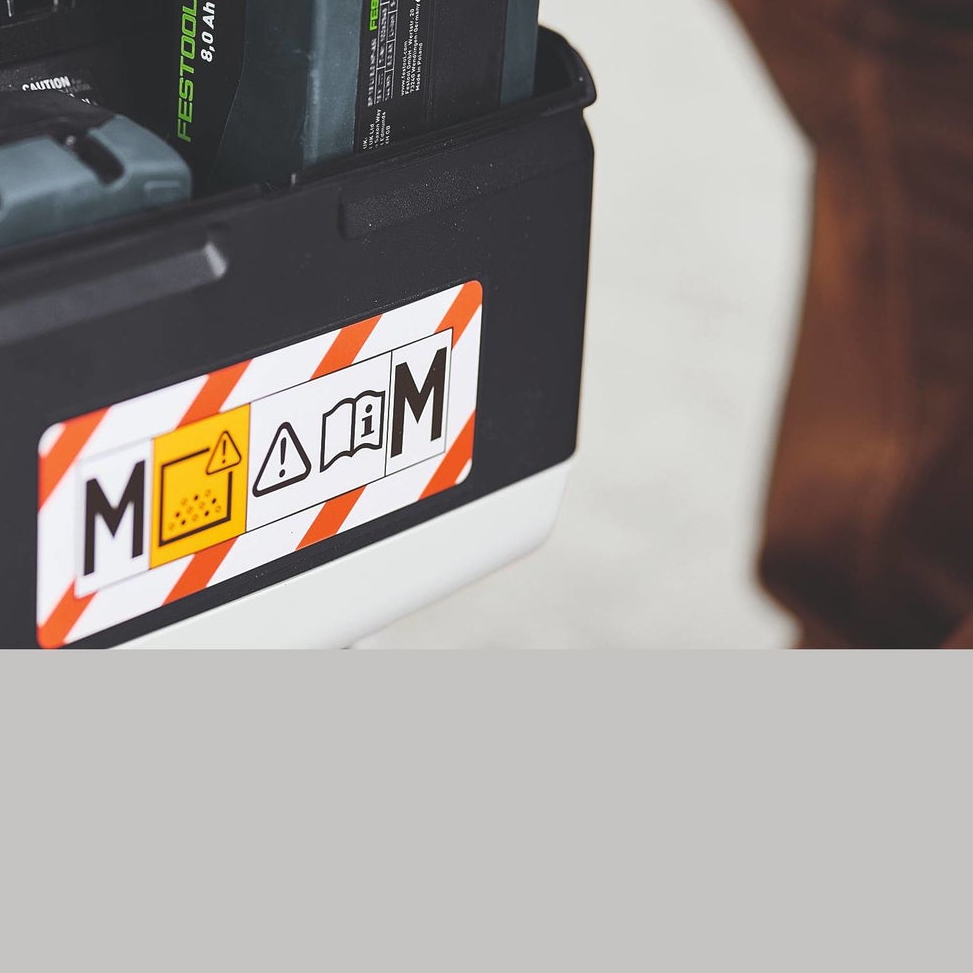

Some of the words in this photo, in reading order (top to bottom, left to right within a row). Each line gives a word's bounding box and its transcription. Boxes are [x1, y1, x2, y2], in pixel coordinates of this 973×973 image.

[203, 1, 215, 30] Ah
[200, 31, 214, 63] 8,0
[400, 40, 408, 96] www.festool.com
[22, 76, 71, 91] CAUTION
[391, 346, 447, 458] M
[83, 460, 145, 576] M
